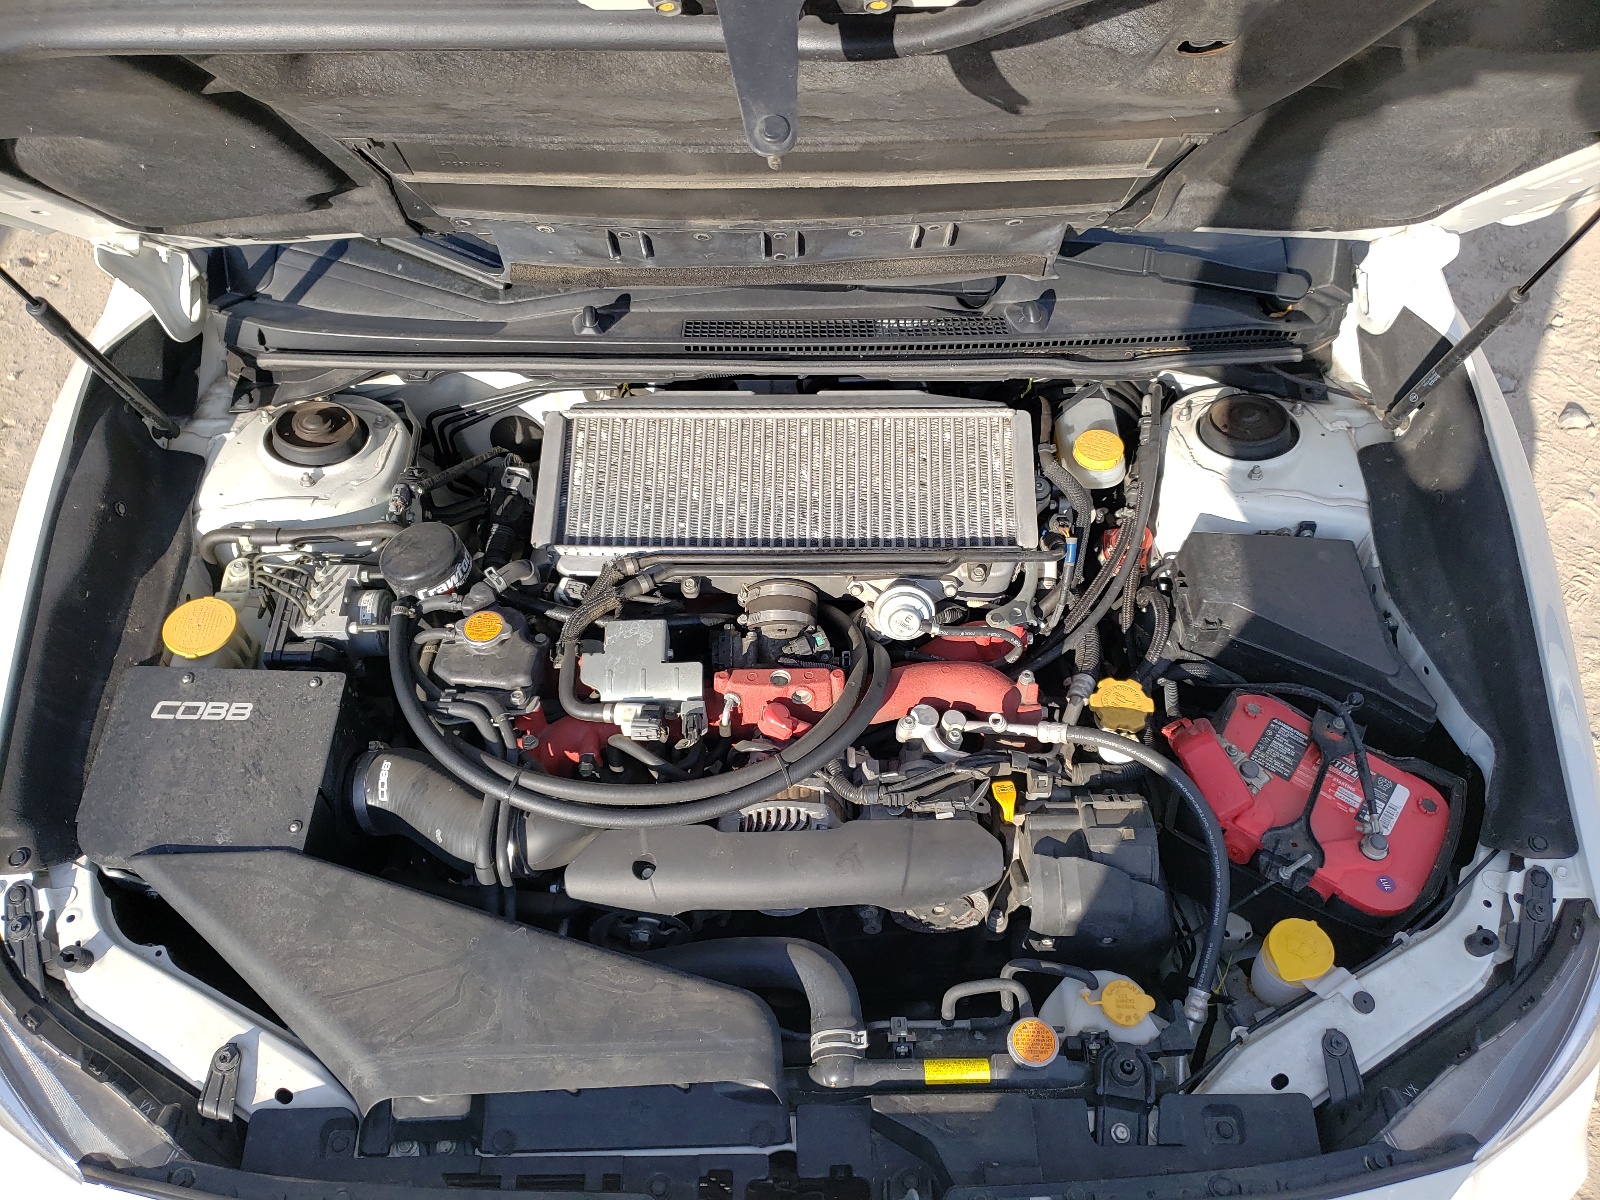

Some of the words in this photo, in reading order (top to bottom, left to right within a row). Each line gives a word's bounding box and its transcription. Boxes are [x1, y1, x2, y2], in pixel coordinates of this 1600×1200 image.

[150, 700, 254, 721] COBB
[1330, 759, 1360, 779] TIMA
[378, 760, 392, 802] COBB
